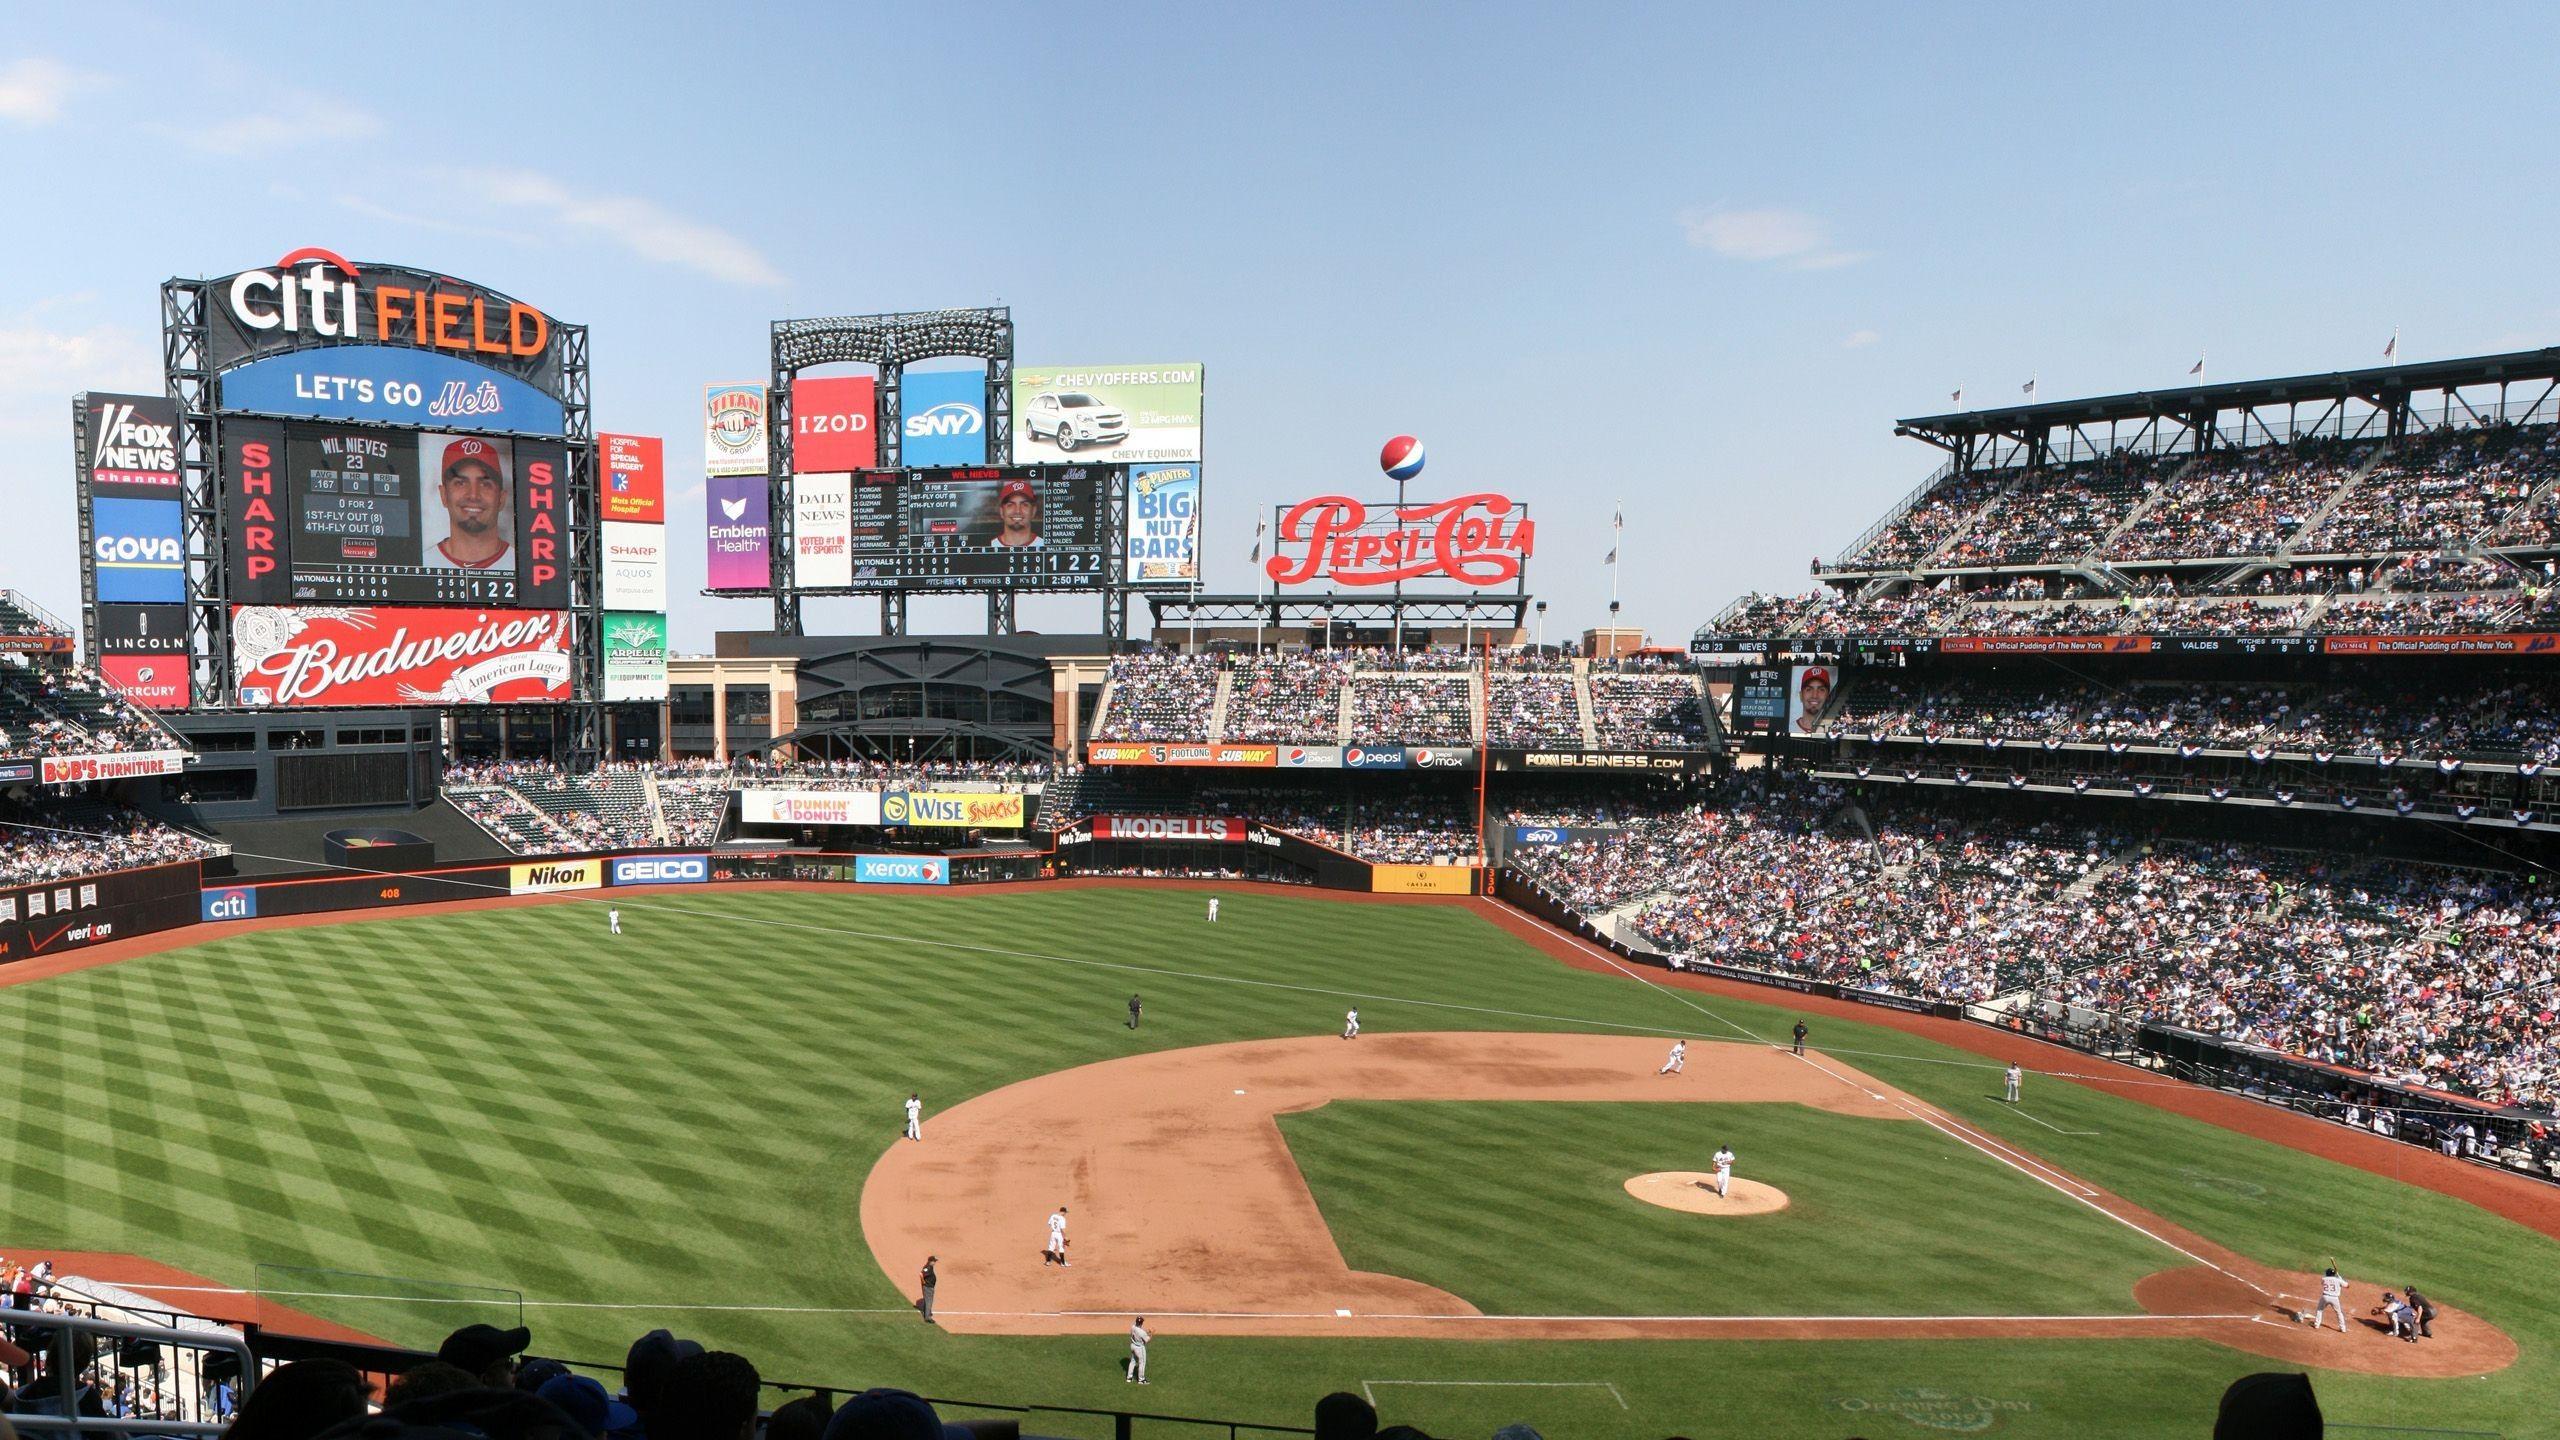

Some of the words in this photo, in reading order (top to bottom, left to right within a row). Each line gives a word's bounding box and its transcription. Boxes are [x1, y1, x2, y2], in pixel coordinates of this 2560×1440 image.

[376, 285, 548, 356] FIELD
[1056, 370, 1195, 387] CHEVYOFFERS.COM
[295, 373, 375, 404] LET'S
[383, 380, 422, 407] GO
[428, 380, 501, 417] Mets
[712, 394, 759, 414] TITAN
[800, 414, 867, 434] IZOD
[904, 409, 976, 437] SNY
[120, 423, 172, 449] FOX
[610, 437, 640, 447] HOSPITAL
[321, 438, 343, 455] WIL
[345, 437, 388, 458] NIEVES
[1112, 449, 1145, 459] CHEVY
[1147, 448, 1193, 458] EQUINOX
[105, 447, 176, 471] NEWS
[346, 455, 363, 470] 23
[610, 453, 640, 463] SPECIAL
[610, 462, 644, 471] SURGERY
[96, 472, 177, 486] channel
[952, 471, 967, 479] WIL
[969, 470, 1000, 478] NIEVES
[1148, 469, 1191, 483] PLANTERS
[314, 480, 334, 489] .167
[348, 501, 365, 509] FOR
[800, 493, 844, 504] DAILY
[1137, 492, 1190, 519] BIG
[241, 442, 275, 580] SHARP
[305, 510, 345, 521] 1ST-FLY
[347, 513, 368, 522] OUT
[800, 510, 845, 521] NEWS
[305, 522, 346, 533] 4TH-FLY
[348, 524, 369, 533] OUT
[529, 461, 556, 586] SHARP
[1146, 520, 1182, 536] NUT
[709, 524, 766, 538] Emblem
[717, 539, 759, 552] Health
[799, 536, 824, 546] VOTED
[825, 536, 836, 545] #1
[837, 535, 844, 545] IN
[1130, 537, 1193, 558] BARS
[95, 536, 180, 562] GOYA
[610, 546, 656, 556] SHARP
[801, 545, 813, 555] NY
[814, 545, 843, 554] SPORTS
[293, 575, 335, 583] NATIONALS
[615, 569, 652, 579] AQUOS
[1052, 576, 1071, 584] 2:50
[1074, 576, 1088, 584] PM
[104, 638, 183, 648] LINCOLN
[1694, 643, 1710, 651] 2:49
[1714, 643, 1723, 651] 23
[1738, 642, 1767, 651] NIEVES
[1995, 642, 2018, 650] Official
[2019, 642, 2047, 651] Pudding
[2048, 642, 2056, 650] of
[2056, 642, 2069, 650] The
[2089, 642, 2103, 650] York
[2377, 642, 2390, 650] The
[2391, 642, 2416, 650] Official
[2418, 642, 2449, 652] Pudding
[2450, 641, 2459, 650] of
[2460, 641, 2475, 650] The
[2476, 641, 2495, 650] New
[2496, 641, 2513, 649] York
[257, 613, 551, 704] Budweiser
[611, 649, 661, 657] ARPIELLE
[468, 662, 525, 690] American
[529, 659, 564, 674] Lager
[116, 686, 176, 697] MERCURY
[1093, 748, 1146, 760] SUBWAY
[1150, 746, 1166, 763] $5
[1171, 748, 1210, 758] FOOTLONG
[1217, 750, 1272, 762] SUBWAY
[1366, 752, 1400, 763] pepsi
[1435, 757, 1462, 766] max
[44, 759, 98, 782] BOB'S
[100, 759, 165, 778] FURNITURE
[793, 800, 850, 810] DUNKIN'
[912, 798, 964, 820] WISE
[967, 798, 1020, 824] SNACKS
[793, 810, 848, 821] DONUTS
[1110, 817, 1227, 840] MODELL'S
[1059, 833, 1074, 846] Mo's
[1074, 831, 1092, 844] Zone
[1248, 830, 1262, 843] Mo's
[1263, 833, 1281, 847] Zone
[1526, 830, 1555, 842] SNY
[528, 866, 585, 885] Nikon
[617, 860, 703, 881] GEICO
[713, 870, 731, 879] 415
[865, 861, 919, 878] xerox
[380, 889, 400, 899] 408
[210, 895, 246, 917] citi
[67, 923, 112, 942] verizon
[1710, 968, 1736, 978] NATIONAL
[1738, 973, 1762, 982] PASTIME
